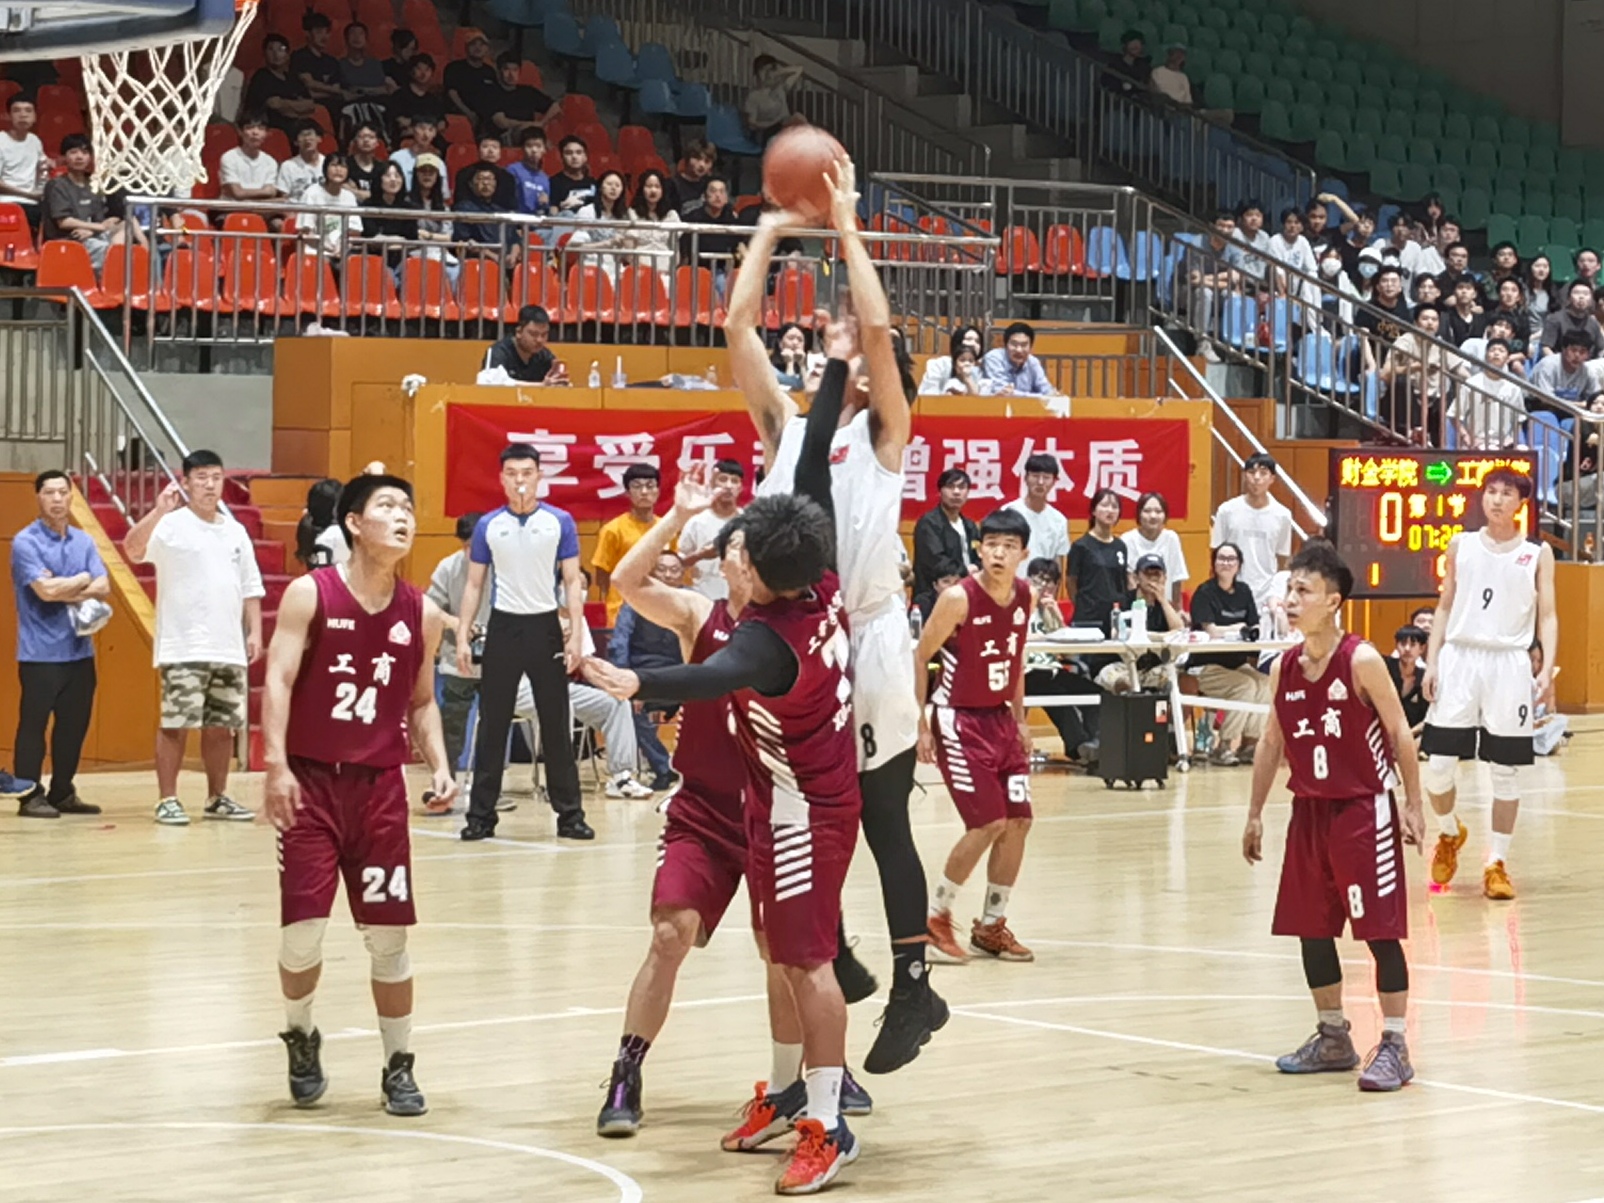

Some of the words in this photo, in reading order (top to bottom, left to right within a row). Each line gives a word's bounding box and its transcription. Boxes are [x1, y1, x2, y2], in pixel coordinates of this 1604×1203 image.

[507, 428, 766, 499] 享受乐
[902, 435, 1143, 502] 增强体质
[1341, 457, 1418, 487] 财金学院
[1380, 492, 1402, 541] 0
[1482, 588, 1494, 610] 9
[328, 652, 396, 686] 工商
[331, 682, 377, 724] 24
[1518, 704, 1528, 727] 9
[1292, 707, 1341, 738] 工商
[860, 723, 876, 758] 8
[362, 865, 407, 903] 24
[1347, 884, 1365, 919] 8
